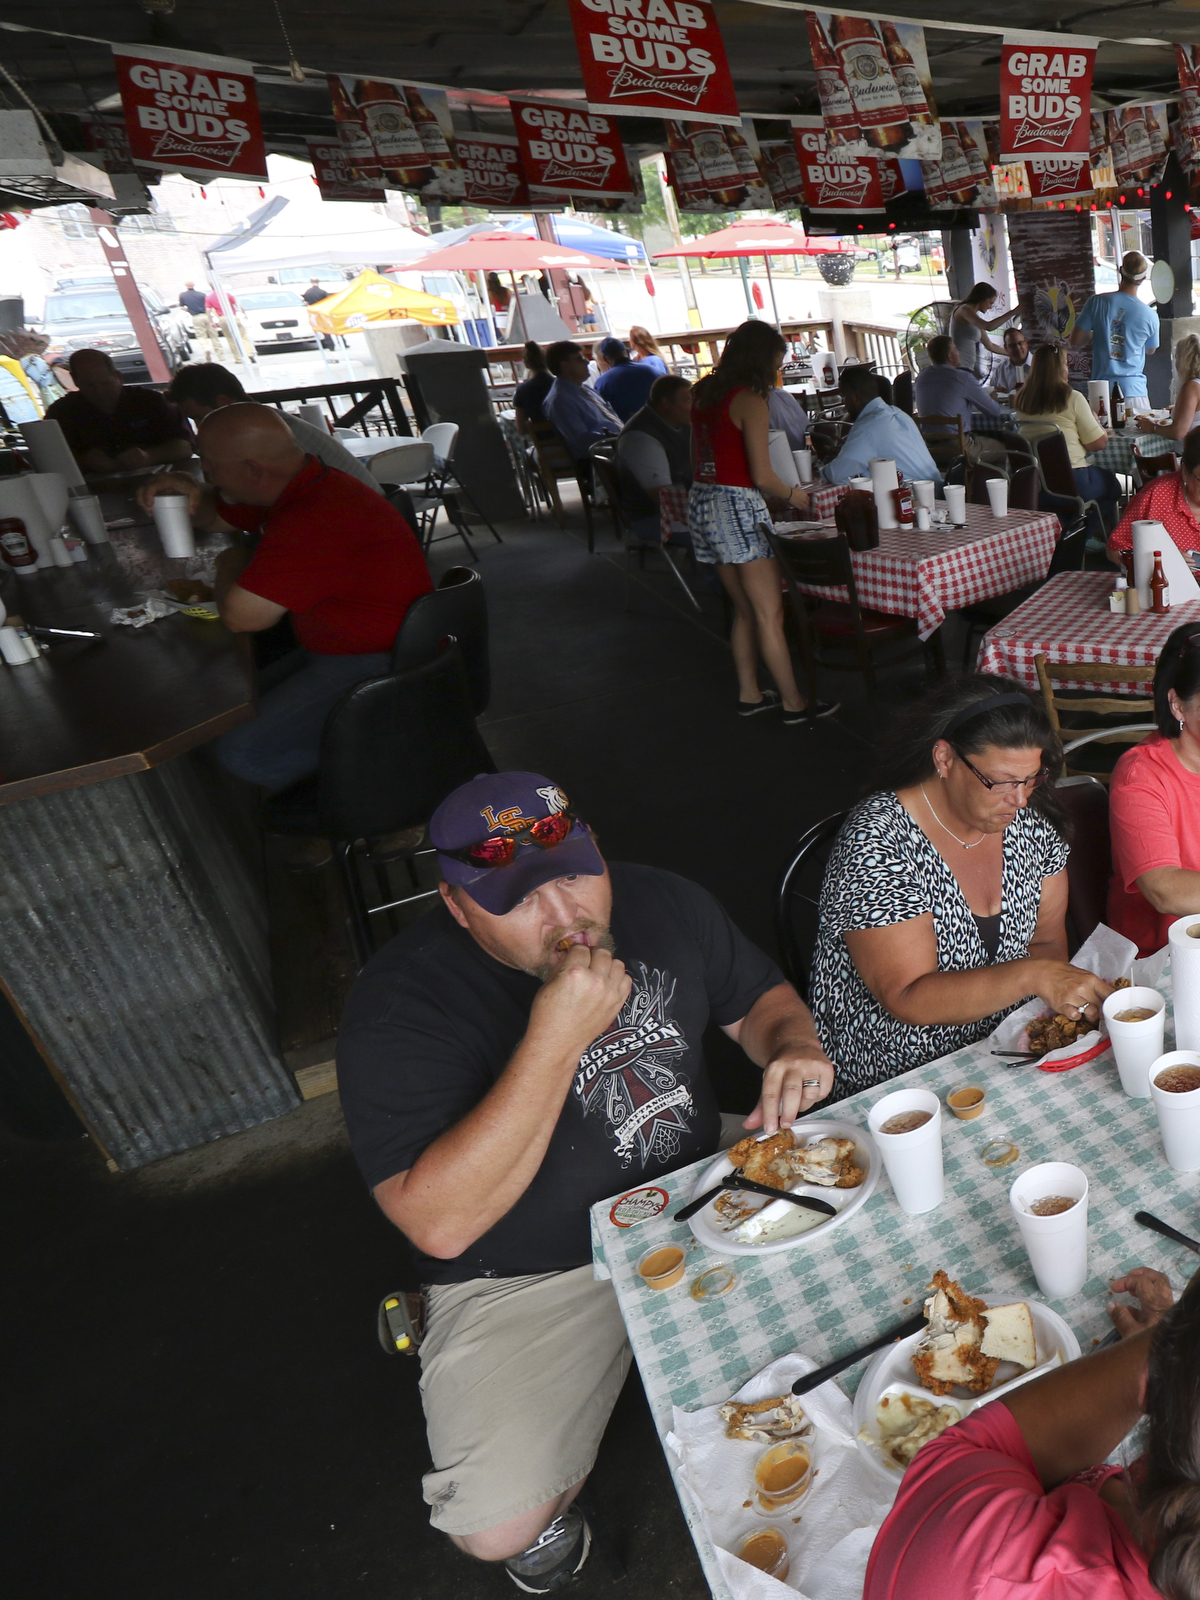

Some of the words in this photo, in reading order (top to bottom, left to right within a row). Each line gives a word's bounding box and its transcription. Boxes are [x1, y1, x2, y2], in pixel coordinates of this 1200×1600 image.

[608, 16, 690, 46] SOME
[590, 33, 716, 76] BUDS
[1008, 52, 1087, 78] GRAB
[129, 65, 247, 103] GRAB
[607, 69, 708, 94] Budweiser
[1021, 78, 1071, 94] SOME
[154, 92, 229, 116] SOME
[1008, 95, 1082, 120] BUDS
[137, 105, 251, 142] BUDS
[521, 107, 611, 134] GRAB
[1014, 122, 1073, 139] Budweiser
[151, 135, 241, 158] Budweiser
[541, 127, 598, 145] SOME
[455, 143, 518, 163] GRAB
[528, 140, 617, 166] BUDS
[816, 151, 859, 165] SOME
[467, 159, 508, 172] SOME
[540, 163, 610, 179] Budweiser
[807, 165, 872, 184] BUDS
[462, 169, 521, 187] BUDS
[816, 182, 867, 198] Budweiser
[580, 1017, 659, 1068] RONNIE
[576, 1023, 680, 1095] JOHNSON
[618, 1089, 684, 1136] CHATTANOOGA
[634, 1102, 667, 1125] FLASH
[619, 1197, 663, 1212] CHAMPYS
